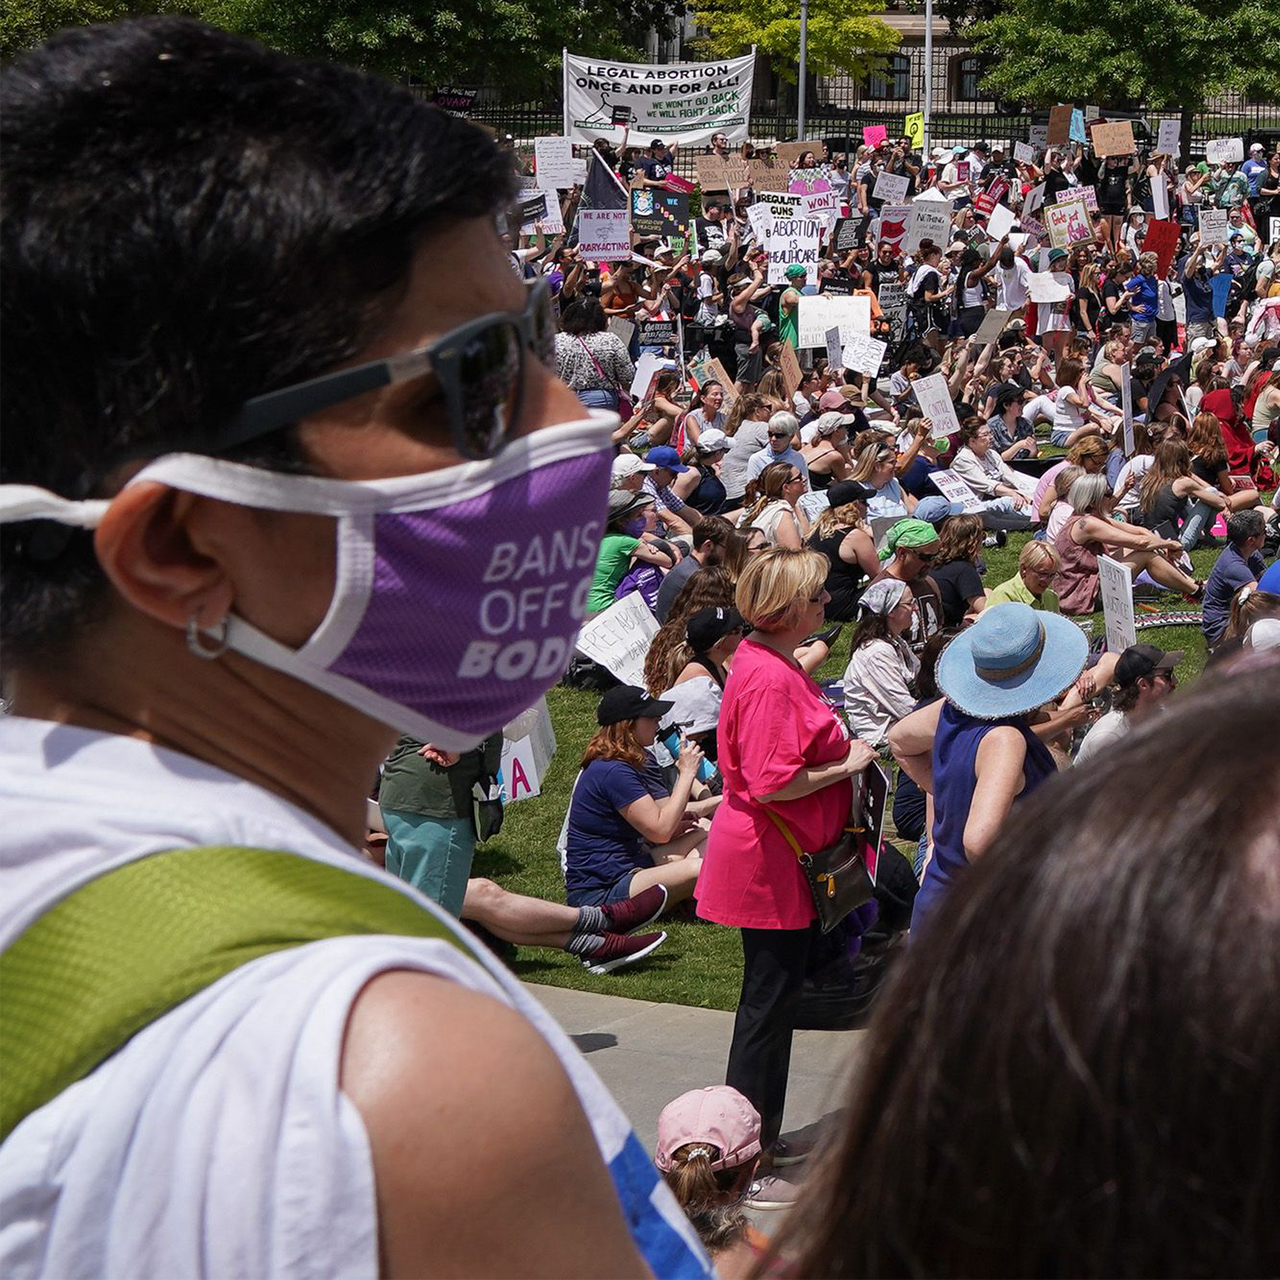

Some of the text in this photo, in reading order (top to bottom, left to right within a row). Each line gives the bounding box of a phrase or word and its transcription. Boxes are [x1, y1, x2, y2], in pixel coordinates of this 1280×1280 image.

[587, 65, 728, 80] LEGAL ABORTION
[576, 76, 739, 95] ONCE AND FOR ALL!
[652, 90, 740, 110] WE WON'T GO BACK
[646, 103, 740, 119] WE WILL FIGHT BACK!
[666, 198, 678, 206] WE
[762, 194, 802, 206] REGULATE
[807, 193, 838, 209] WON'T
[770, 206, 794, 216] GUNS
[772, 219, 820, 238] ABORTION
[789, 239, 798, 249] IS
[769, 248, 820, 263] HEALTHCARE
[483, 522, 598, 584] BANS
[479, 582, 569, 636] OFF
[577, 620, 624, 658] FREE
